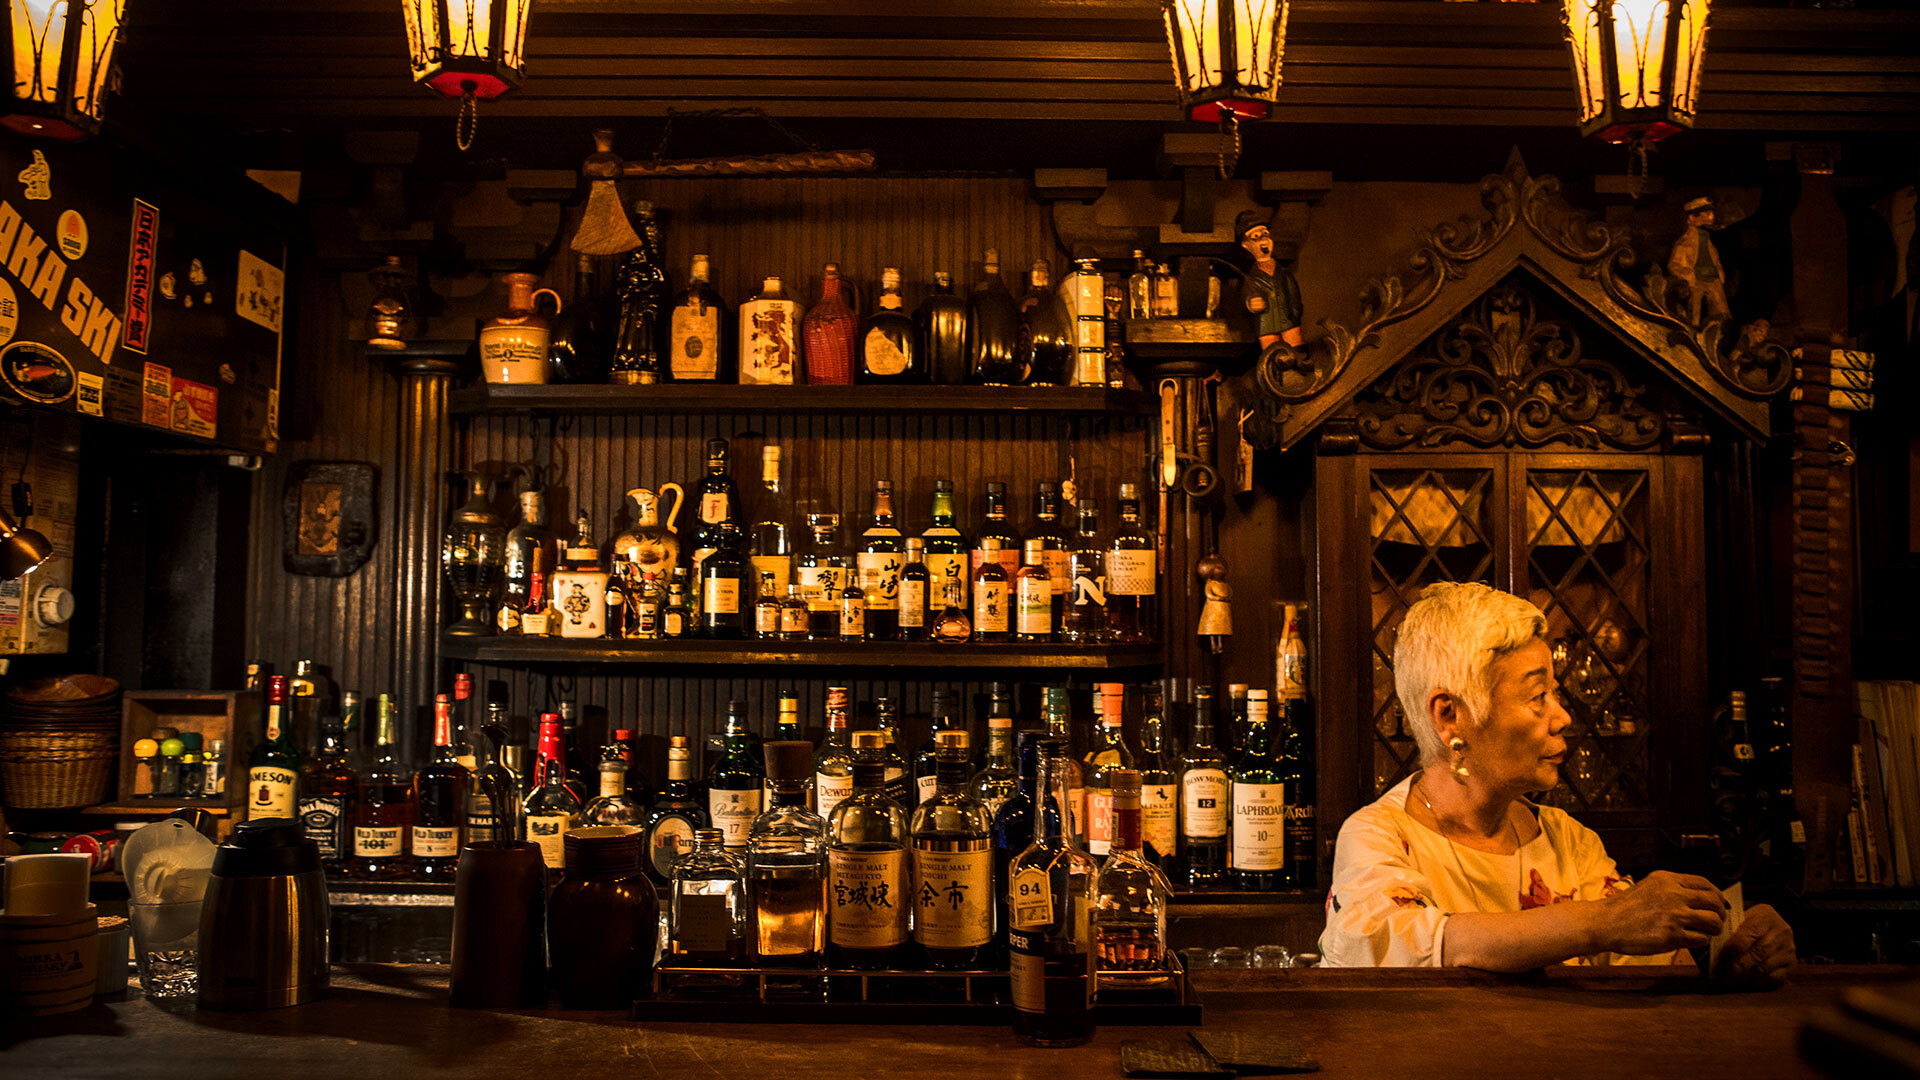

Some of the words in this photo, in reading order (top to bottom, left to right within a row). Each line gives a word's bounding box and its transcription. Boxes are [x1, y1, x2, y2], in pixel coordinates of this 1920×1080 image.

[60, 276, 122, 366] SKI
[880, 558, 900, 601] 山崎
[1074, 575, 1108, 607] N
[249, 771, 293, 785] AMESON
[820, 784, 853, 797] Dewar
[1142, 802, 1175, 810] ALISKER
[1201, 800, 1213, 808] 12
[1236, 805, 1284, 816] LAPHROAI
[729, 824, 740, 835] 17
[1257, 831, 1268, 842] 10
[364, 839, 386, 850] 101
[836, 863, 864, 871] SINGLE
[920, 862, 947, 871] SINGLE
[836, 872, 882, 880] MIYAGIKYO
[920, 871, 947, 880] YOICHI
[1019, 882, 1041, 896] 94
[834, 880, 892, 911] 宮城峡
[918, 880, 969, 911] 余市
